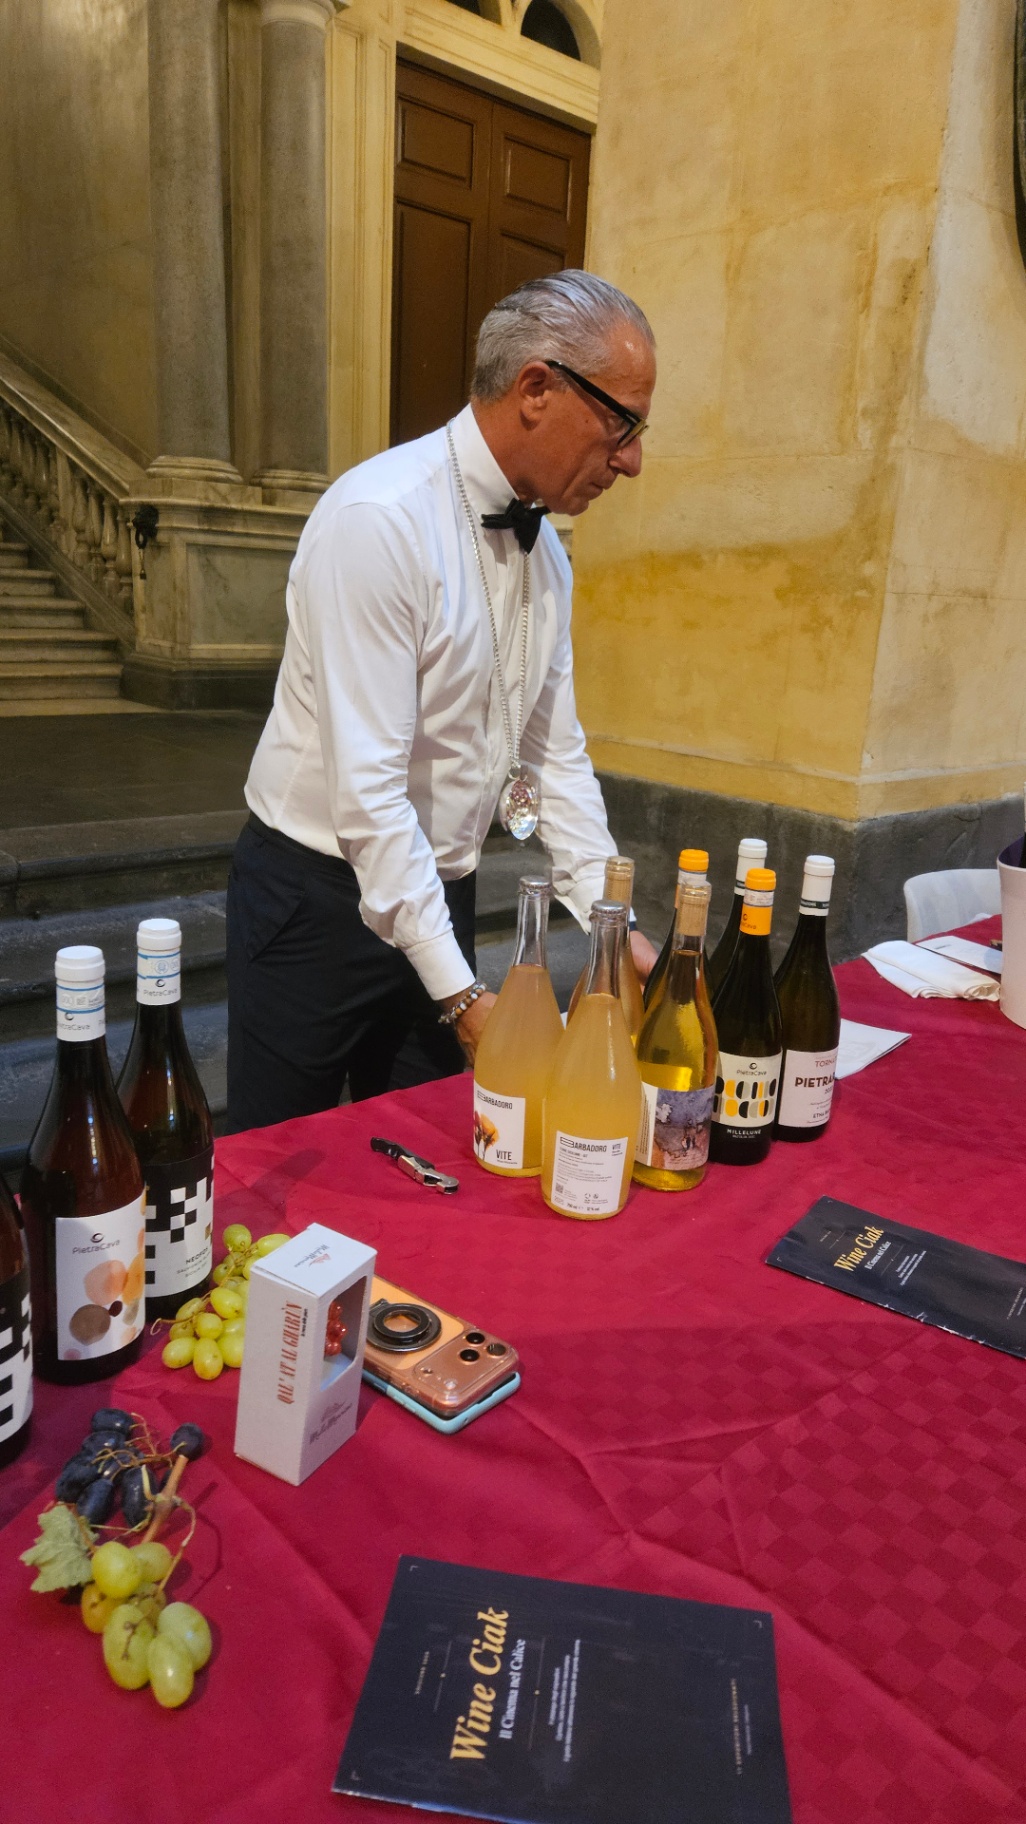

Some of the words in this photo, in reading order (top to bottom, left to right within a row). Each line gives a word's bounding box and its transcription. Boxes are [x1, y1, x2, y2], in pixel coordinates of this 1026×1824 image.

[477, 1090, 513, 1110] BARBADORO
[496, 1150, 512, 1160] VITE
[560, 1136, 607, 1152] BARBADORO
[72, 1239, 121, 1255] PietraCava
[834, 1247, 867, 1272] Wine
[855, 1226, 884, 1249] Ciak
[469, 1607, 509, 1676] Ciak
[510, 1638, 526, 1671] Calice
[509, 1671, 521, 1688] nel
[450, 1683, 496, 1759] Wine
[501, 1689, 519, 1729] Cinema
